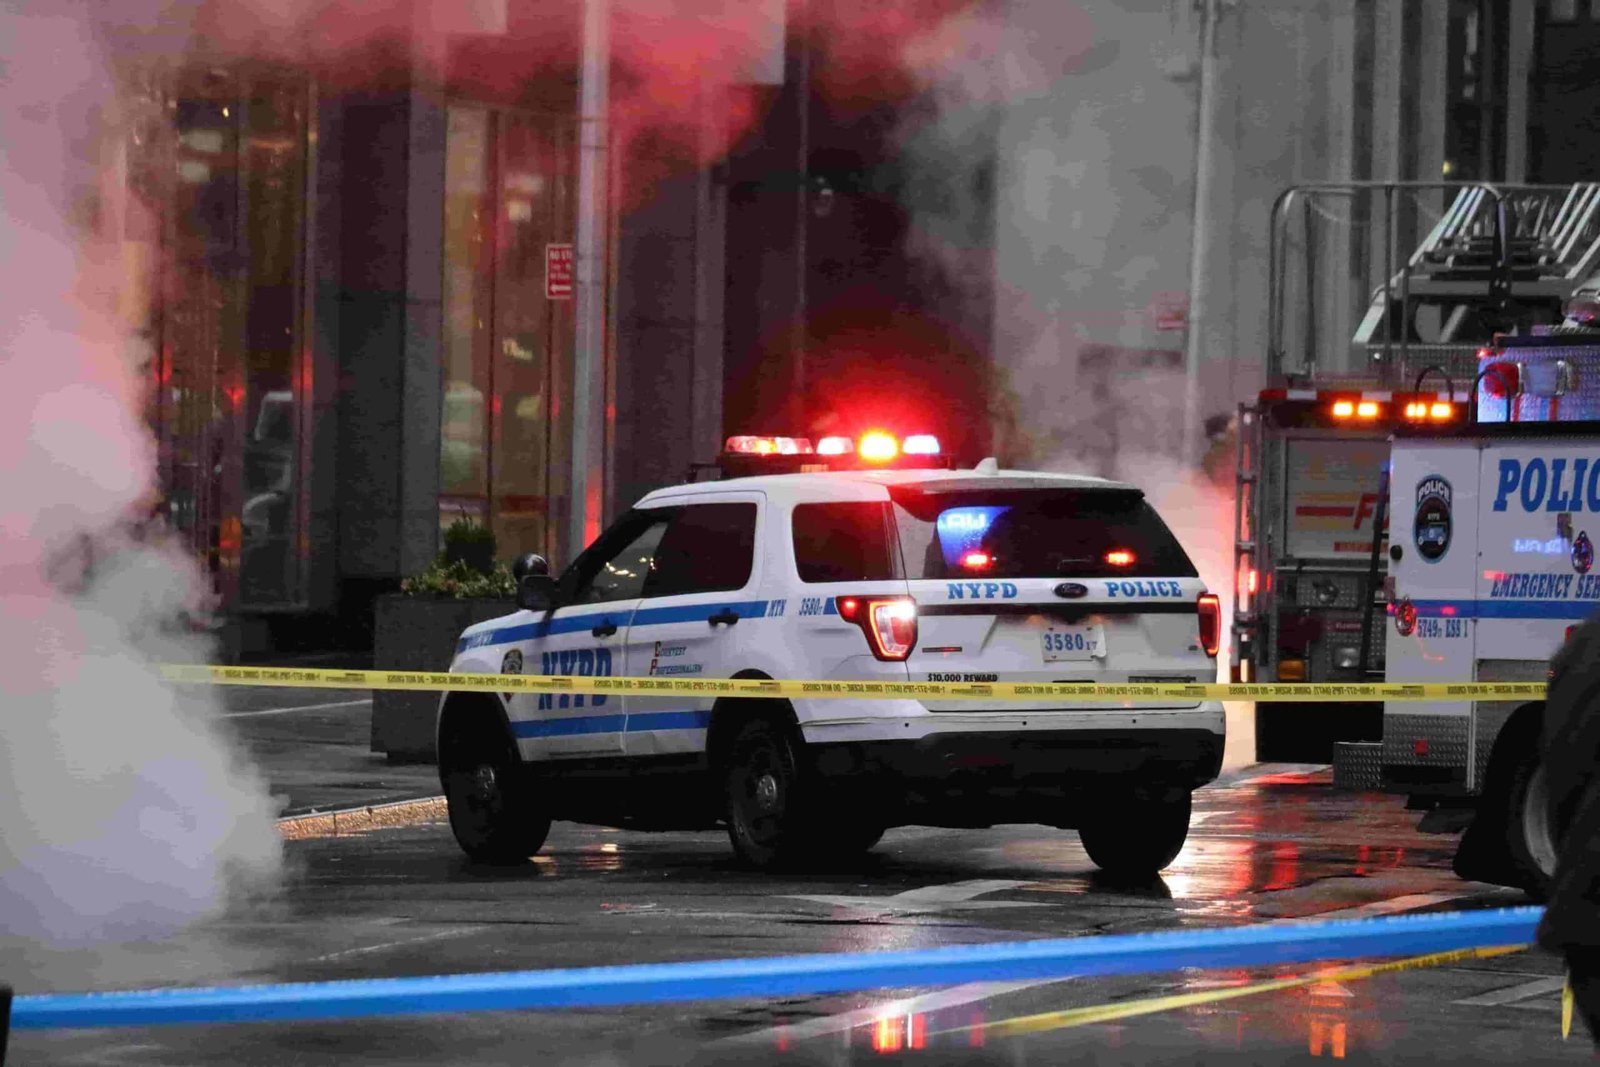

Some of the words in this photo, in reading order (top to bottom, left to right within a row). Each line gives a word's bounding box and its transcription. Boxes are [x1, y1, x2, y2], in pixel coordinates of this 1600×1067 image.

[1418, 480, 1449, 502] POLICE
[947, 583, 1018, 599] NYPD
[1105, 581, 1182, 598] POLICE
[1490, 574, 1573, 598] EMERGENCY
[1446, 619, 1461, 638] ESS
[1044, 633, 1083, 651] 3580
[538, 648, 612, 711] NYPD
[964, 673, 998, 683] REWARD
